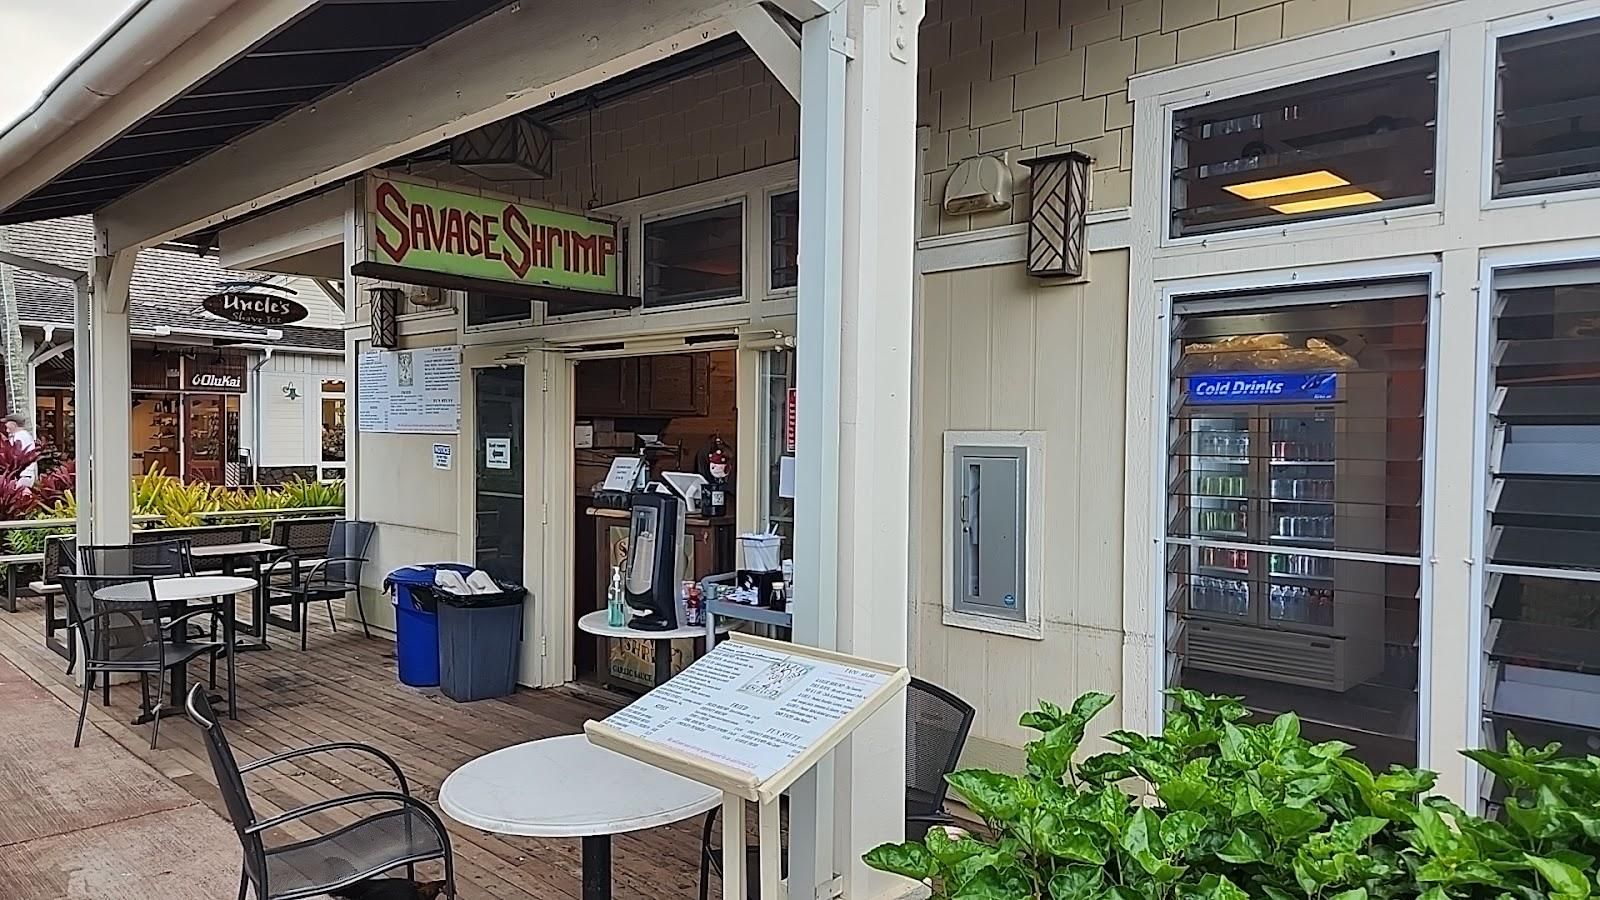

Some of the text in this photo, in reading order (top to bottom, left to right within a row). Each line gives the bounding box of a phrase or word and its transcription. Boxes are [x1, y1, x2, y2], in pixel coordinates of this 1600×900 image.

[376, 181, 502, 263] SAVAGE
[223, 294, 290, 315] Uncle's
[1196, 379, 1284, 396] Cold Drinks
